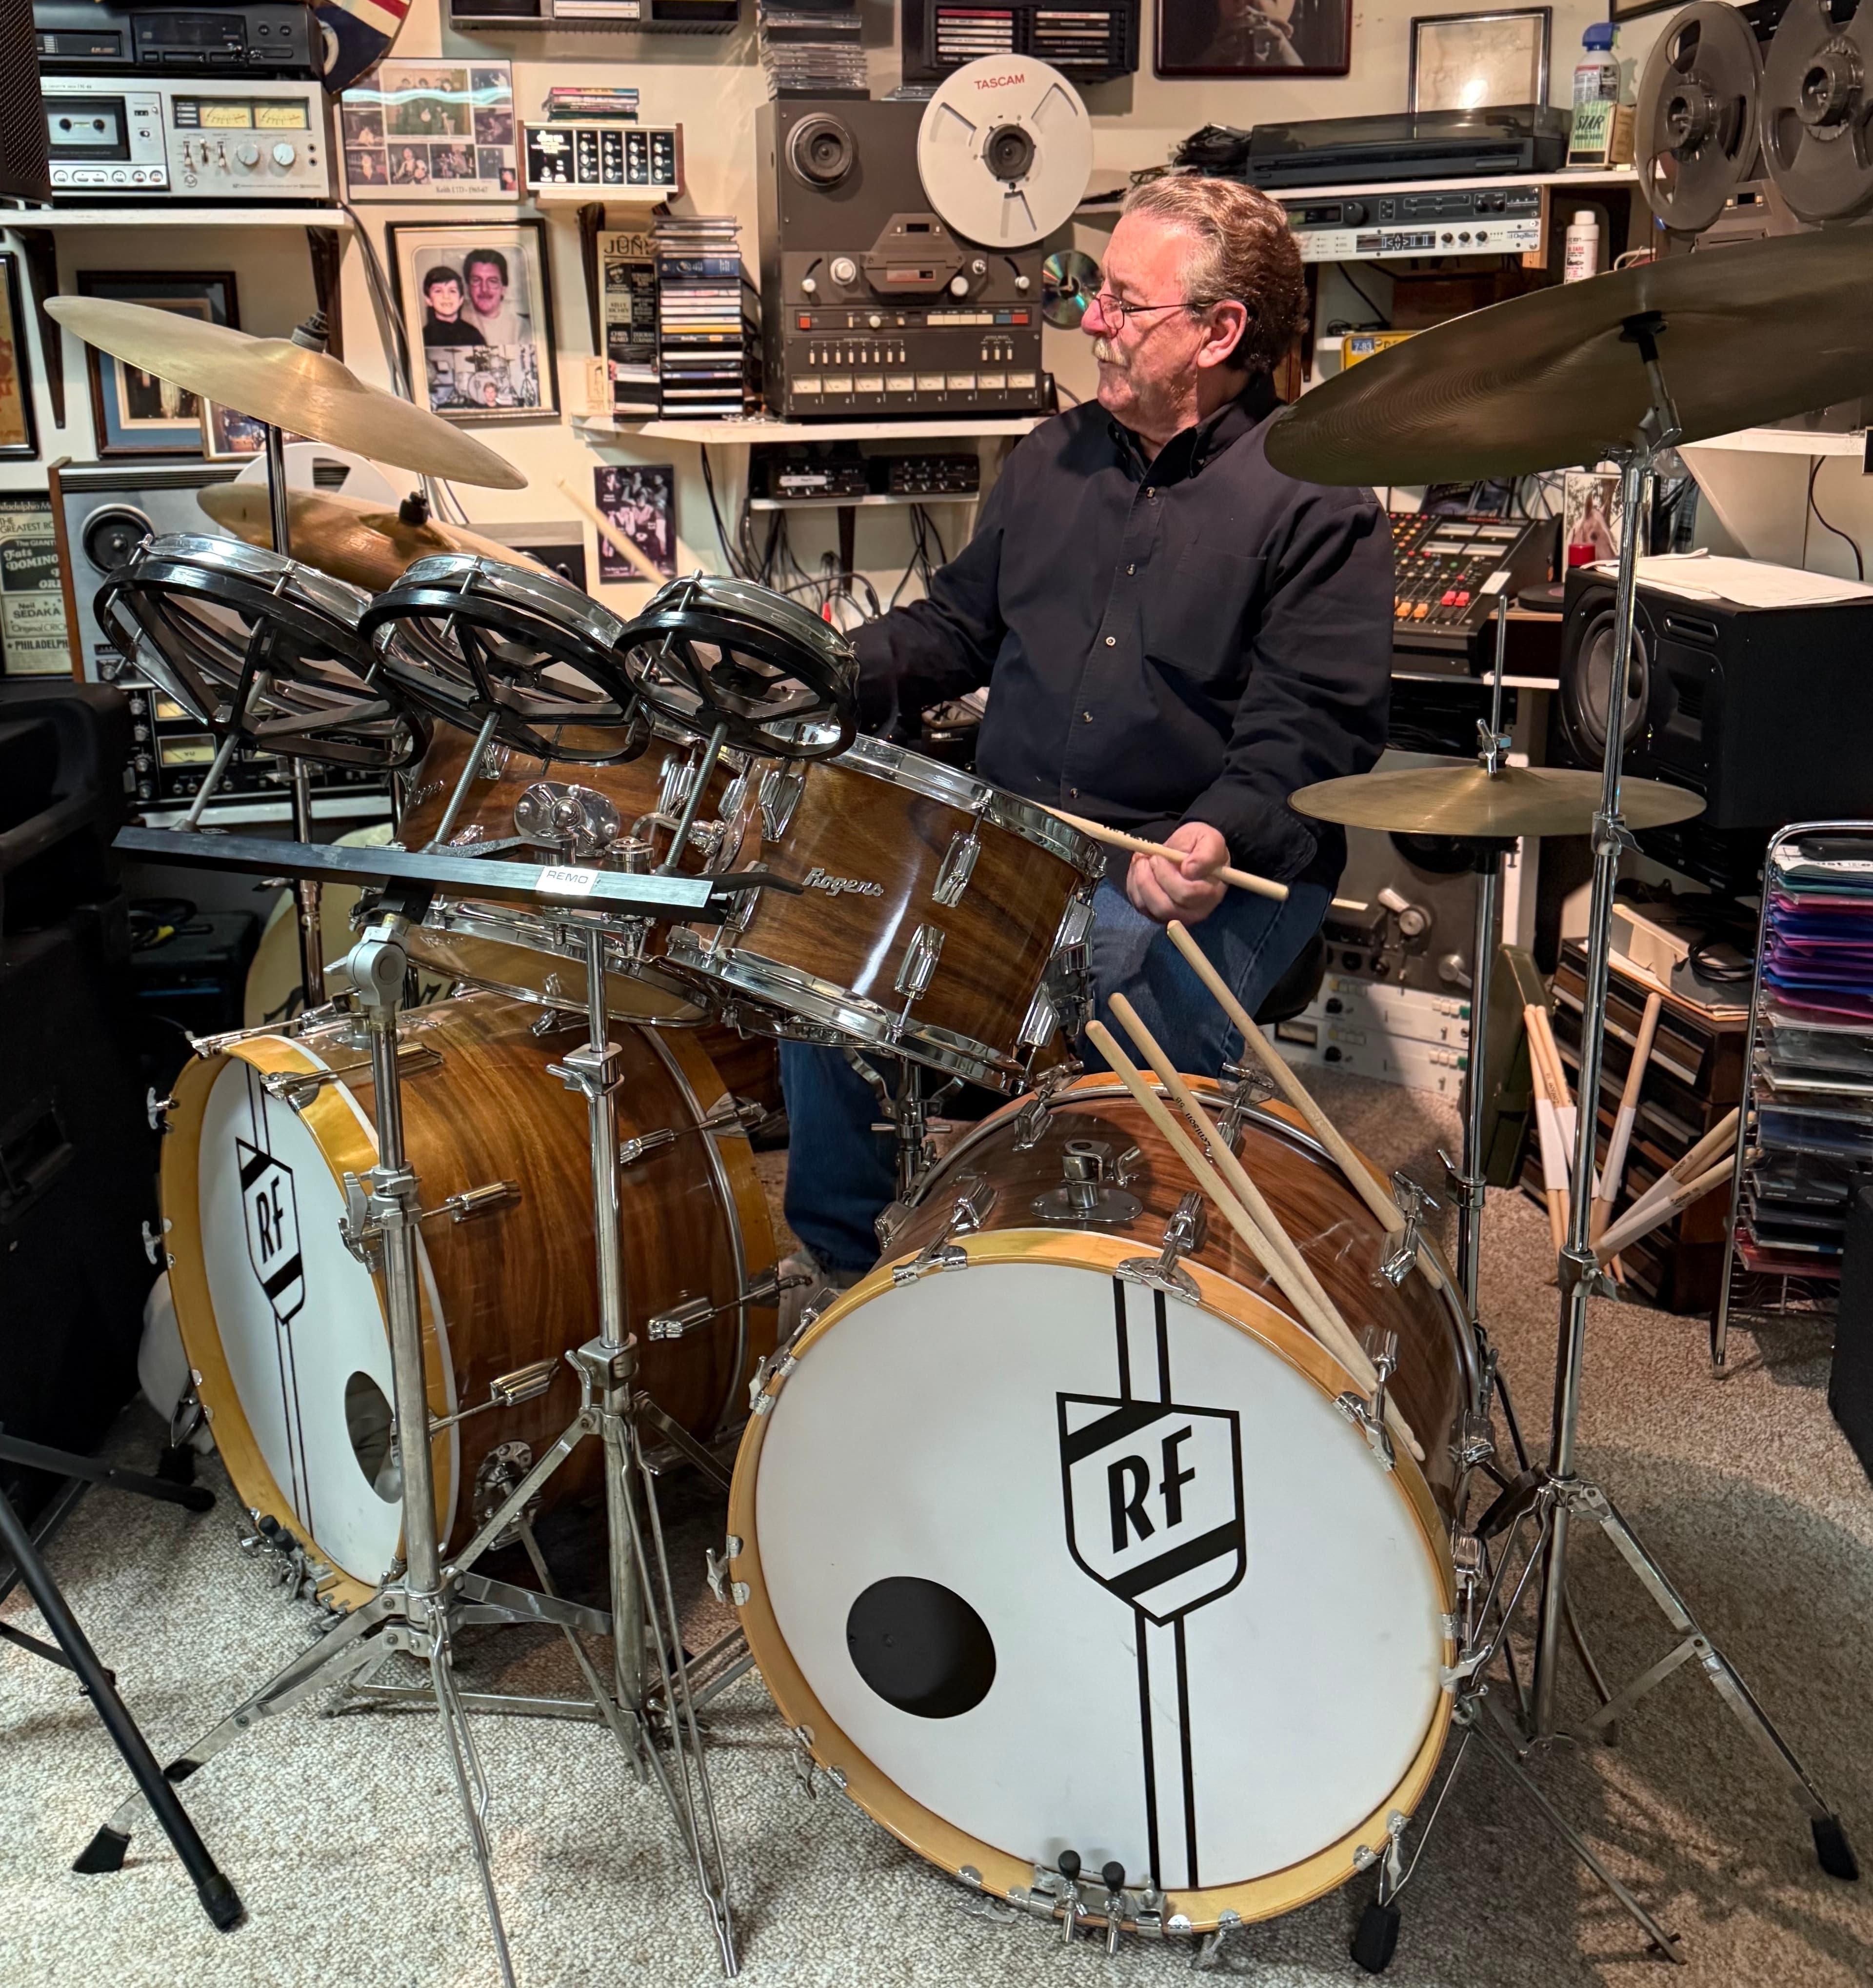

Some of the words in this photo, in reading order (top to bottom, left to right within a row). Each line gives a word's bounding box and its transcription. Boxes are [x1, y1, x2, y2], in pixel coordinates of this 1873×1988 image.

[975, 74, 1025, 90] TASCAM
[1576, 115, 1605, 130] STAR
[0, 522, 40, 534] GREATEST
[3, 548, 33, 561] Fats
[5, 554, 59, 571] DOMINO
[13, 608, 60, 619] SEDAKA
[546, 870, 589, 884] REMO
[801, 867, 884, 897] Rogers
[1176, 1097, 1185, 1108] 5B
[256, 1175, 283, 1265] RF
[1107, 1424, 1196, 1554] RF
